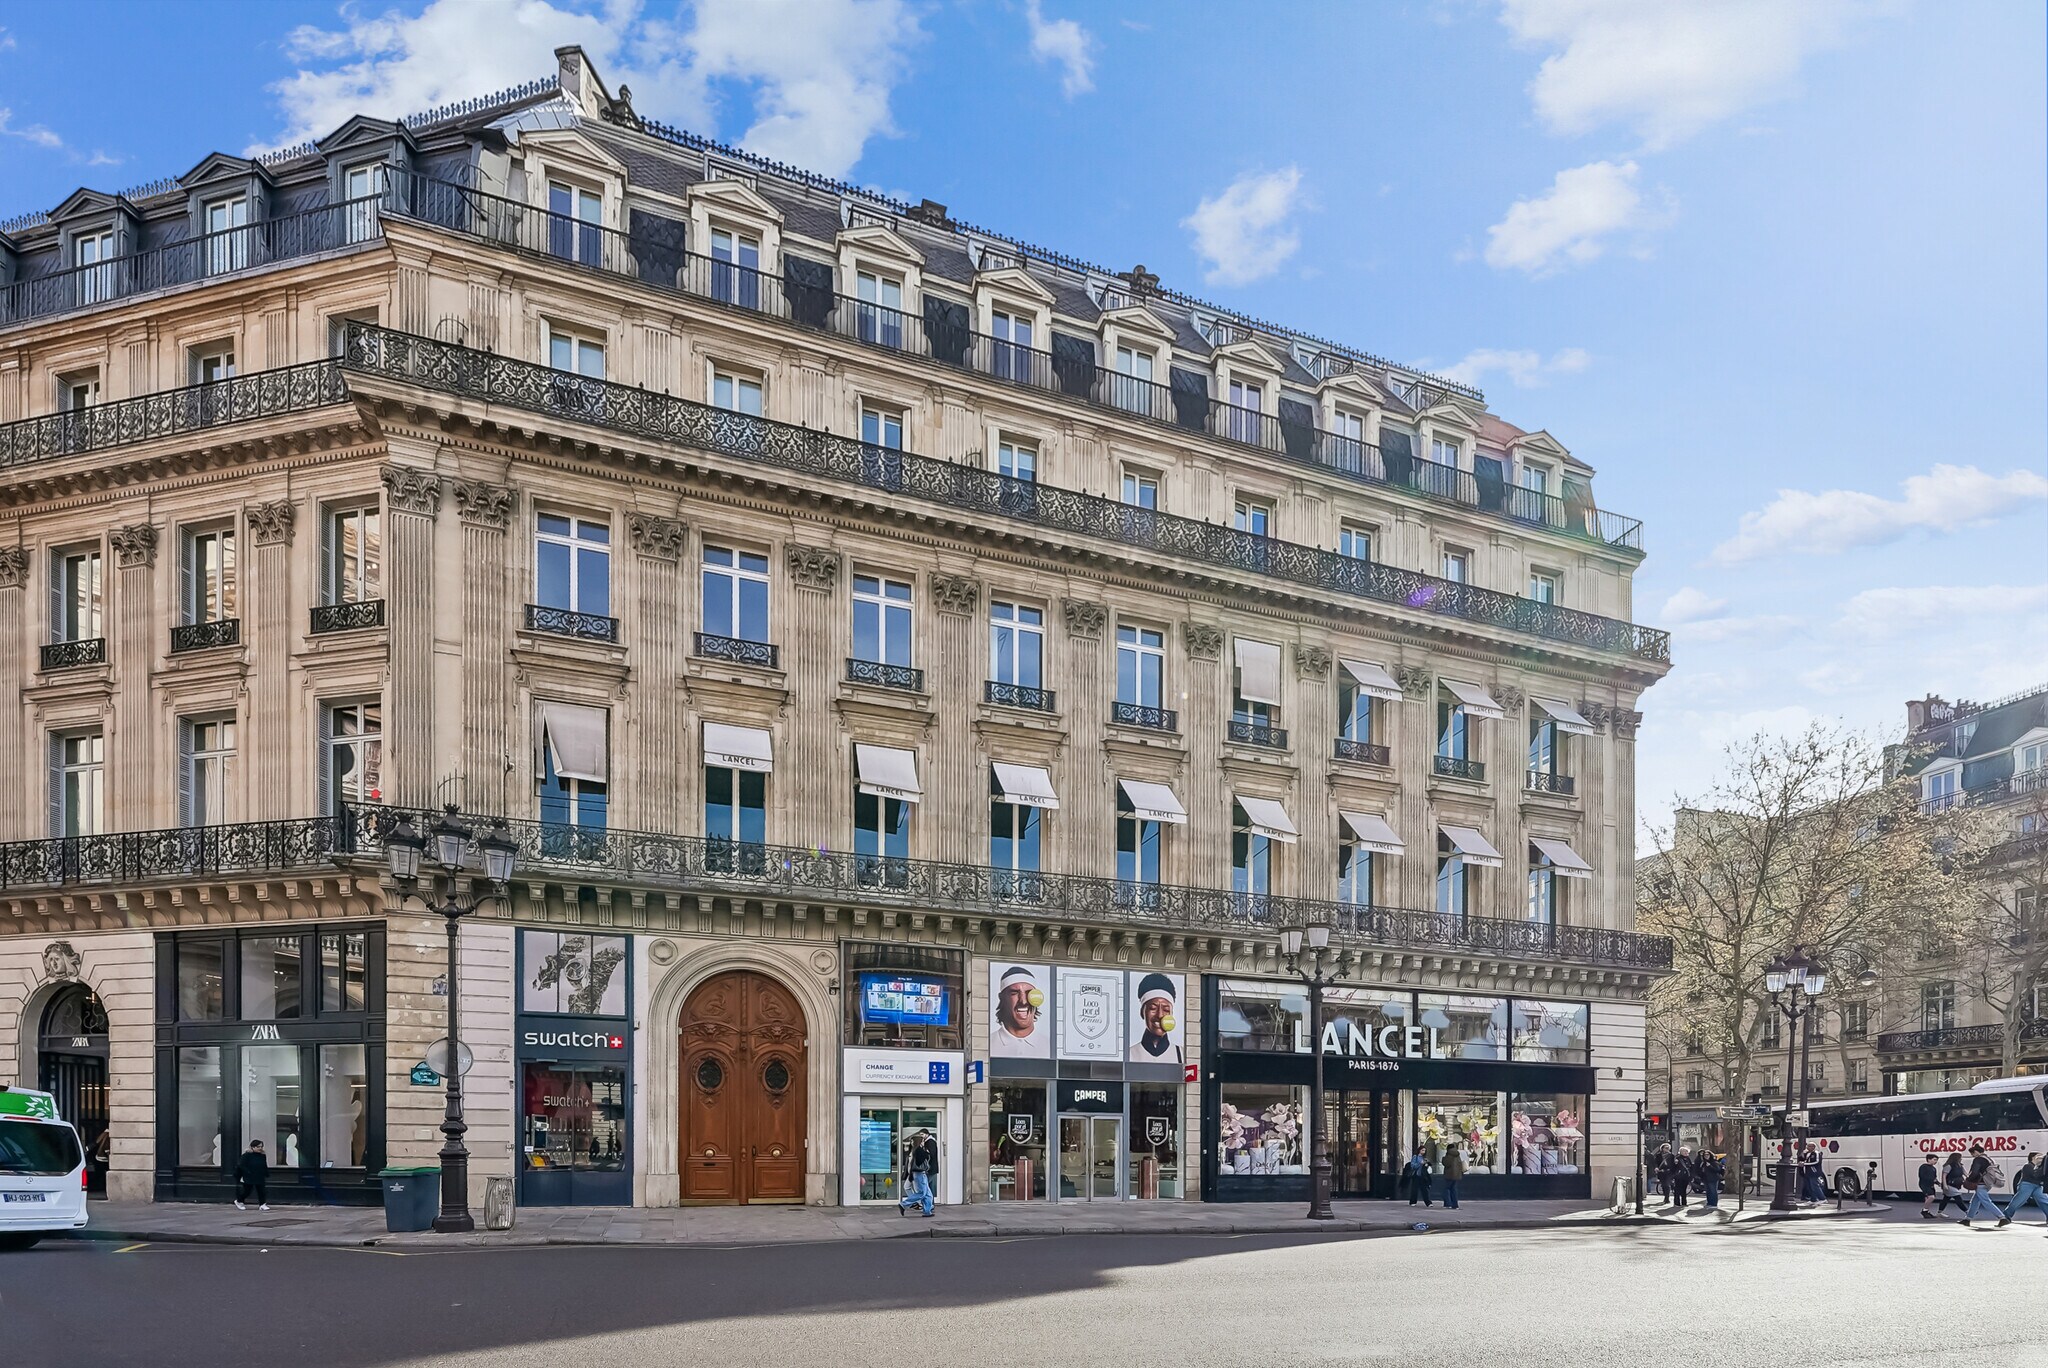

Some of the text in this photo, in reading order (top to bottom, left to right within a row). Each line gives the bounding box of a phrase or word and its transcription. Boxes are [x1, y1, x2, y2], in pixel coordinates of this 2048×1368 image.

[721, 755, 756, 766] LANCEL
[875, 786, 904, 796] LANCEL
[1081, 985, 1101, 993] CAMPER
[1083, 998, 1099, 1007] Loco
[251, 1024, 280, 1040] ZARA
[72, 1037, 89, 1047] ZARA
[524, 1032, 608, 1048] swatch
[1294, 1020, 1446, 1059] LANCEL
[543, 1095, 584, 1107] swatch
[1075, 1090, 1107, 1102] CAMPER
